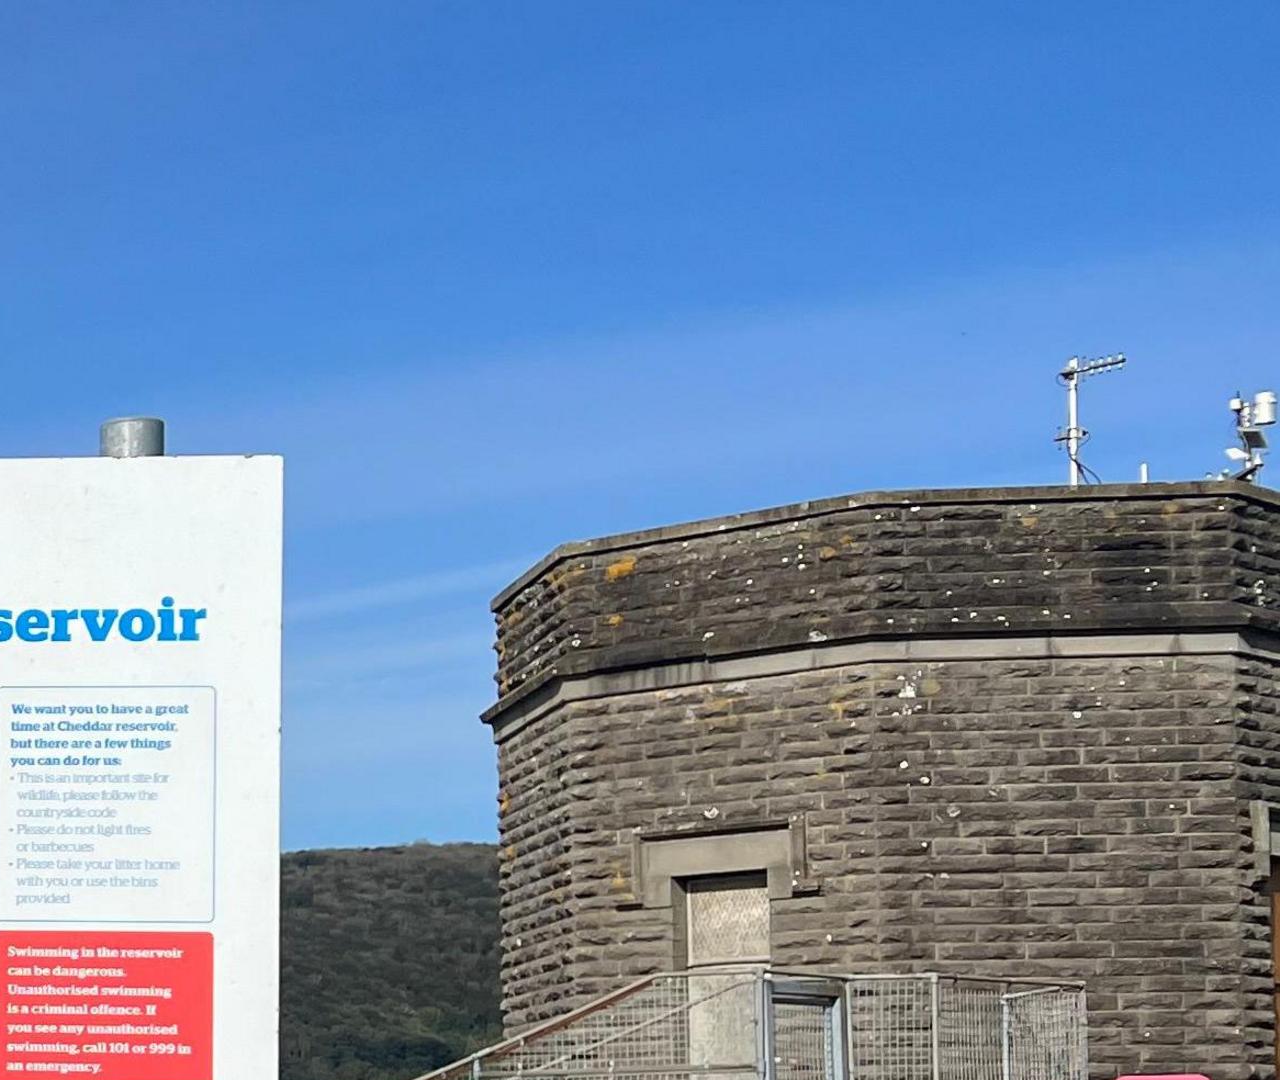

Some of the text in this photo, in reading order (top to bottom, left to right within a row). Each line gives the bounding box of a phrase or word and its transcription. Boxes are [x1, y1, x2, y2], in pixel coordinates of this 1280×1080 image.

[11, 703, 32, 714] We
[34, 704, 66, 714] want
[68, 706, 93, 716] you
[95, 704, 109, 713] to
[110, 703, 142, 714] have
[155, 704, 188, 716] great
[11, 721, 40, 731] time
[42, 721, 54, 731] at
[57, 721, 113, 731] Cheddar
[10, 738, 171, 750] but there are a few things
[10, 757, 35, 767] you
[37, 757, 60, 765] can
[62, 755, 80, 765] do
[82, 755, 101, 765] for
[7, 946, 183, 959] Swimming in the reservoir
[7, 965, 126, 979] can be dangerous.
[7, 984, 172, 998] Unauthorised swimming
[7, 1003, 156, 1015] is a criminal offence. If
[7, 1023, 178, 1035] you see any unauthorised
[82, 1042, 107, 1053] call
[108, 1042, 129, 1053] 101
[131, 1045, 147, 1053] or
[148, 1043, 176, 1054] 999
[176, 1044, 191, 1054] in
[6, 1062, 101, 1073] an emergency.
